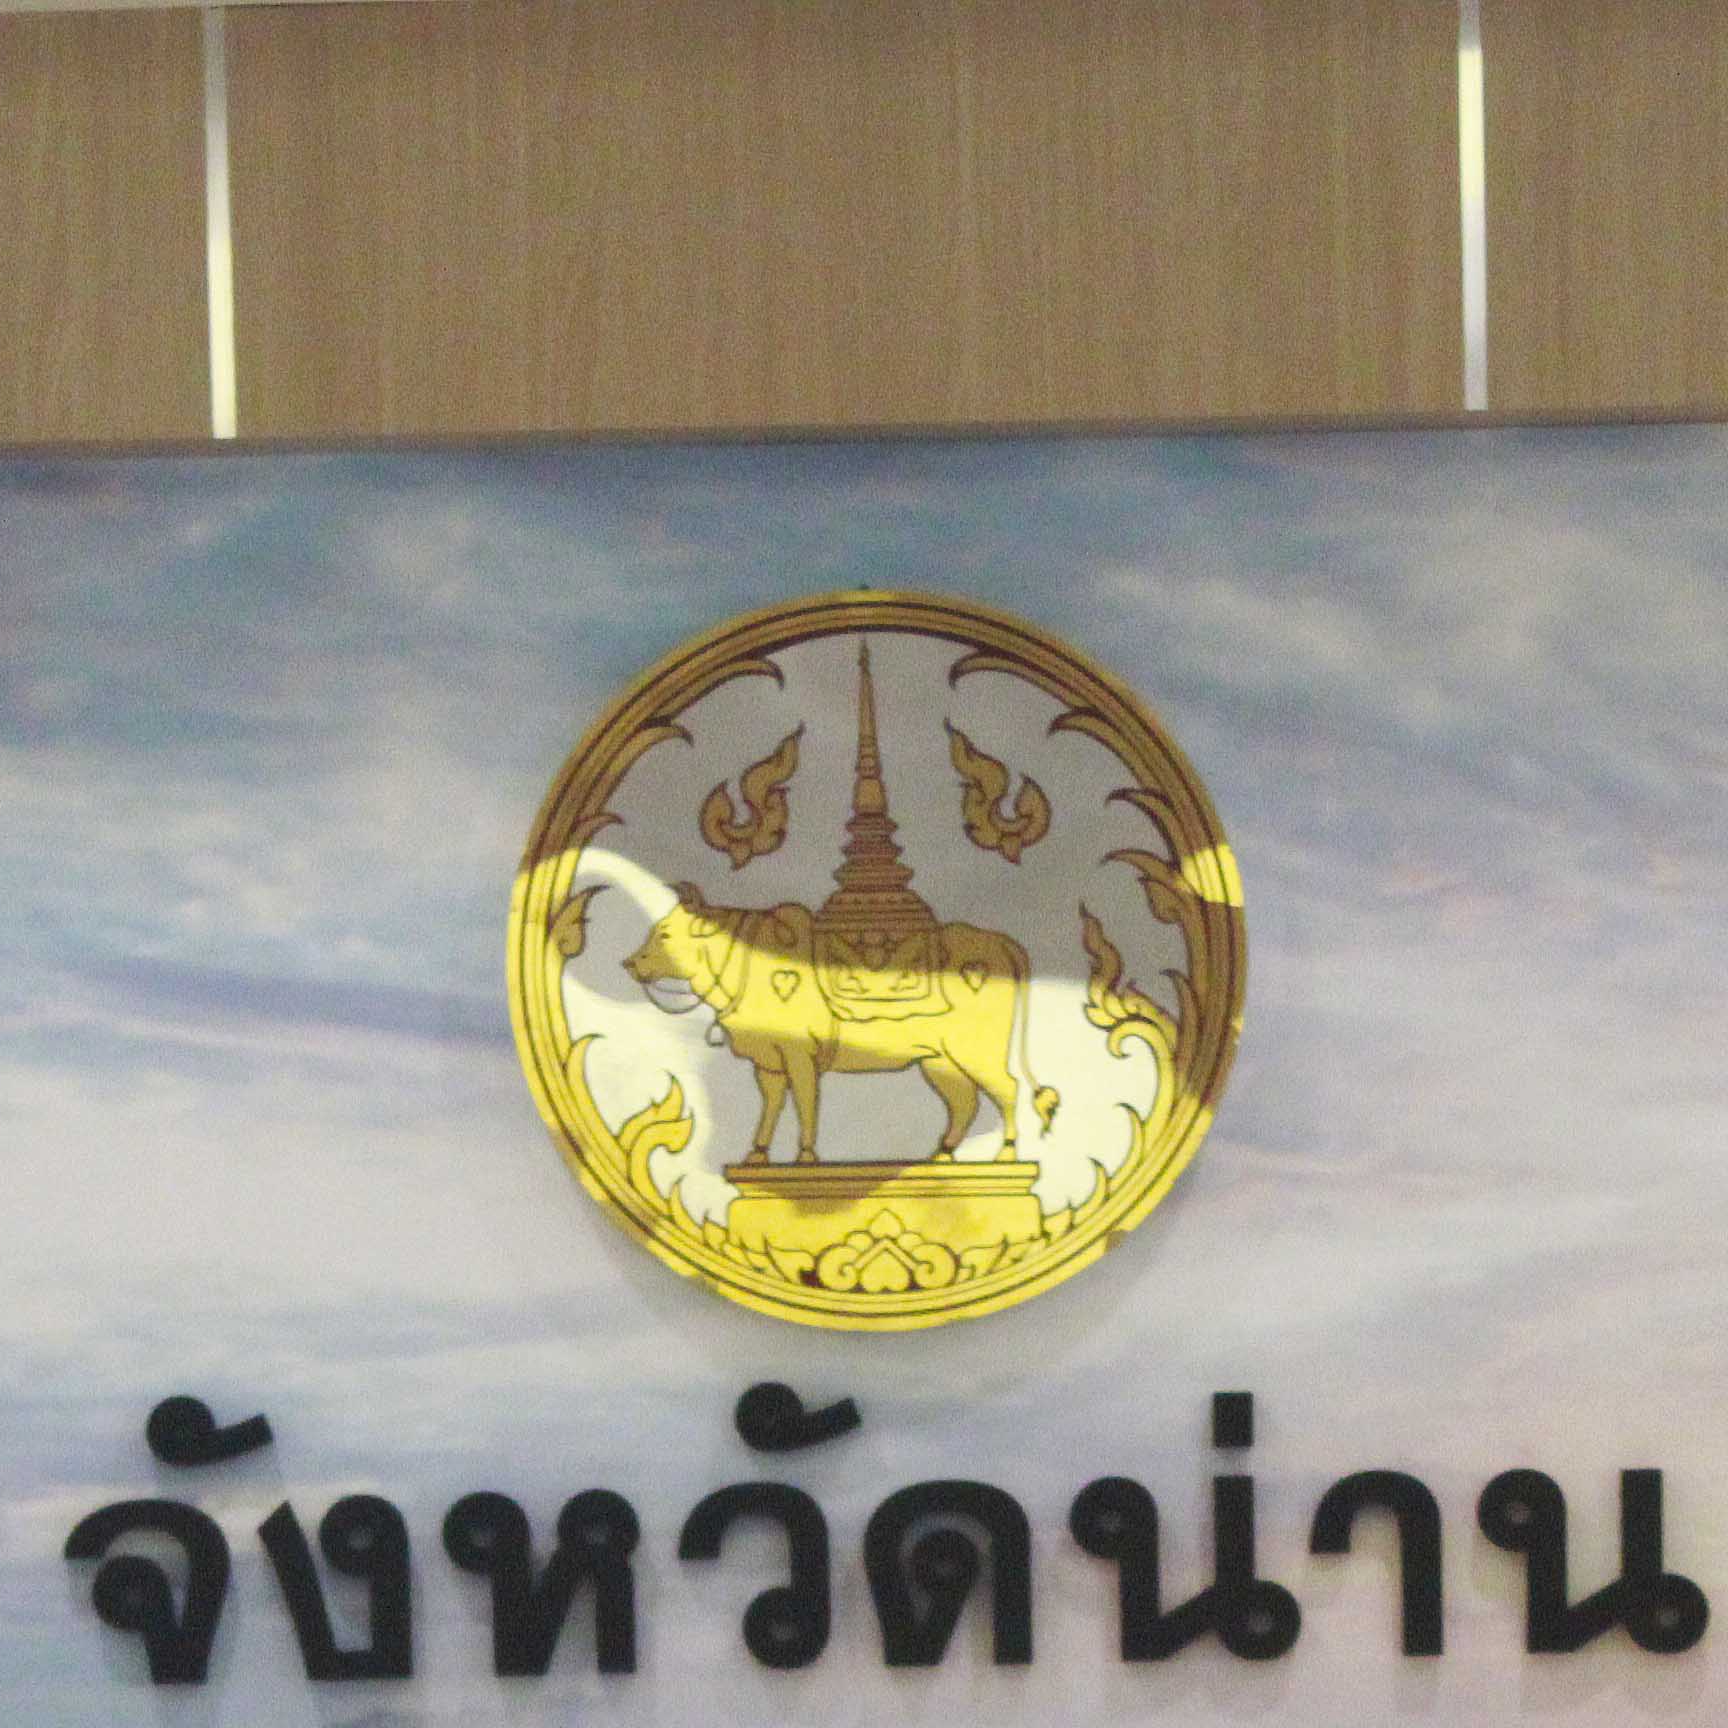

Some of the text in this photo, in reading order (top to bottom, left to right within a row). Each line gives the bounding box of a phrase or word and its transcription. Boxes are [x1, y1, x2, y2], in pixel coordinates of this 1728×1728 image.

[62, 1382, 1710, 1686] จังหวัดน่าน
